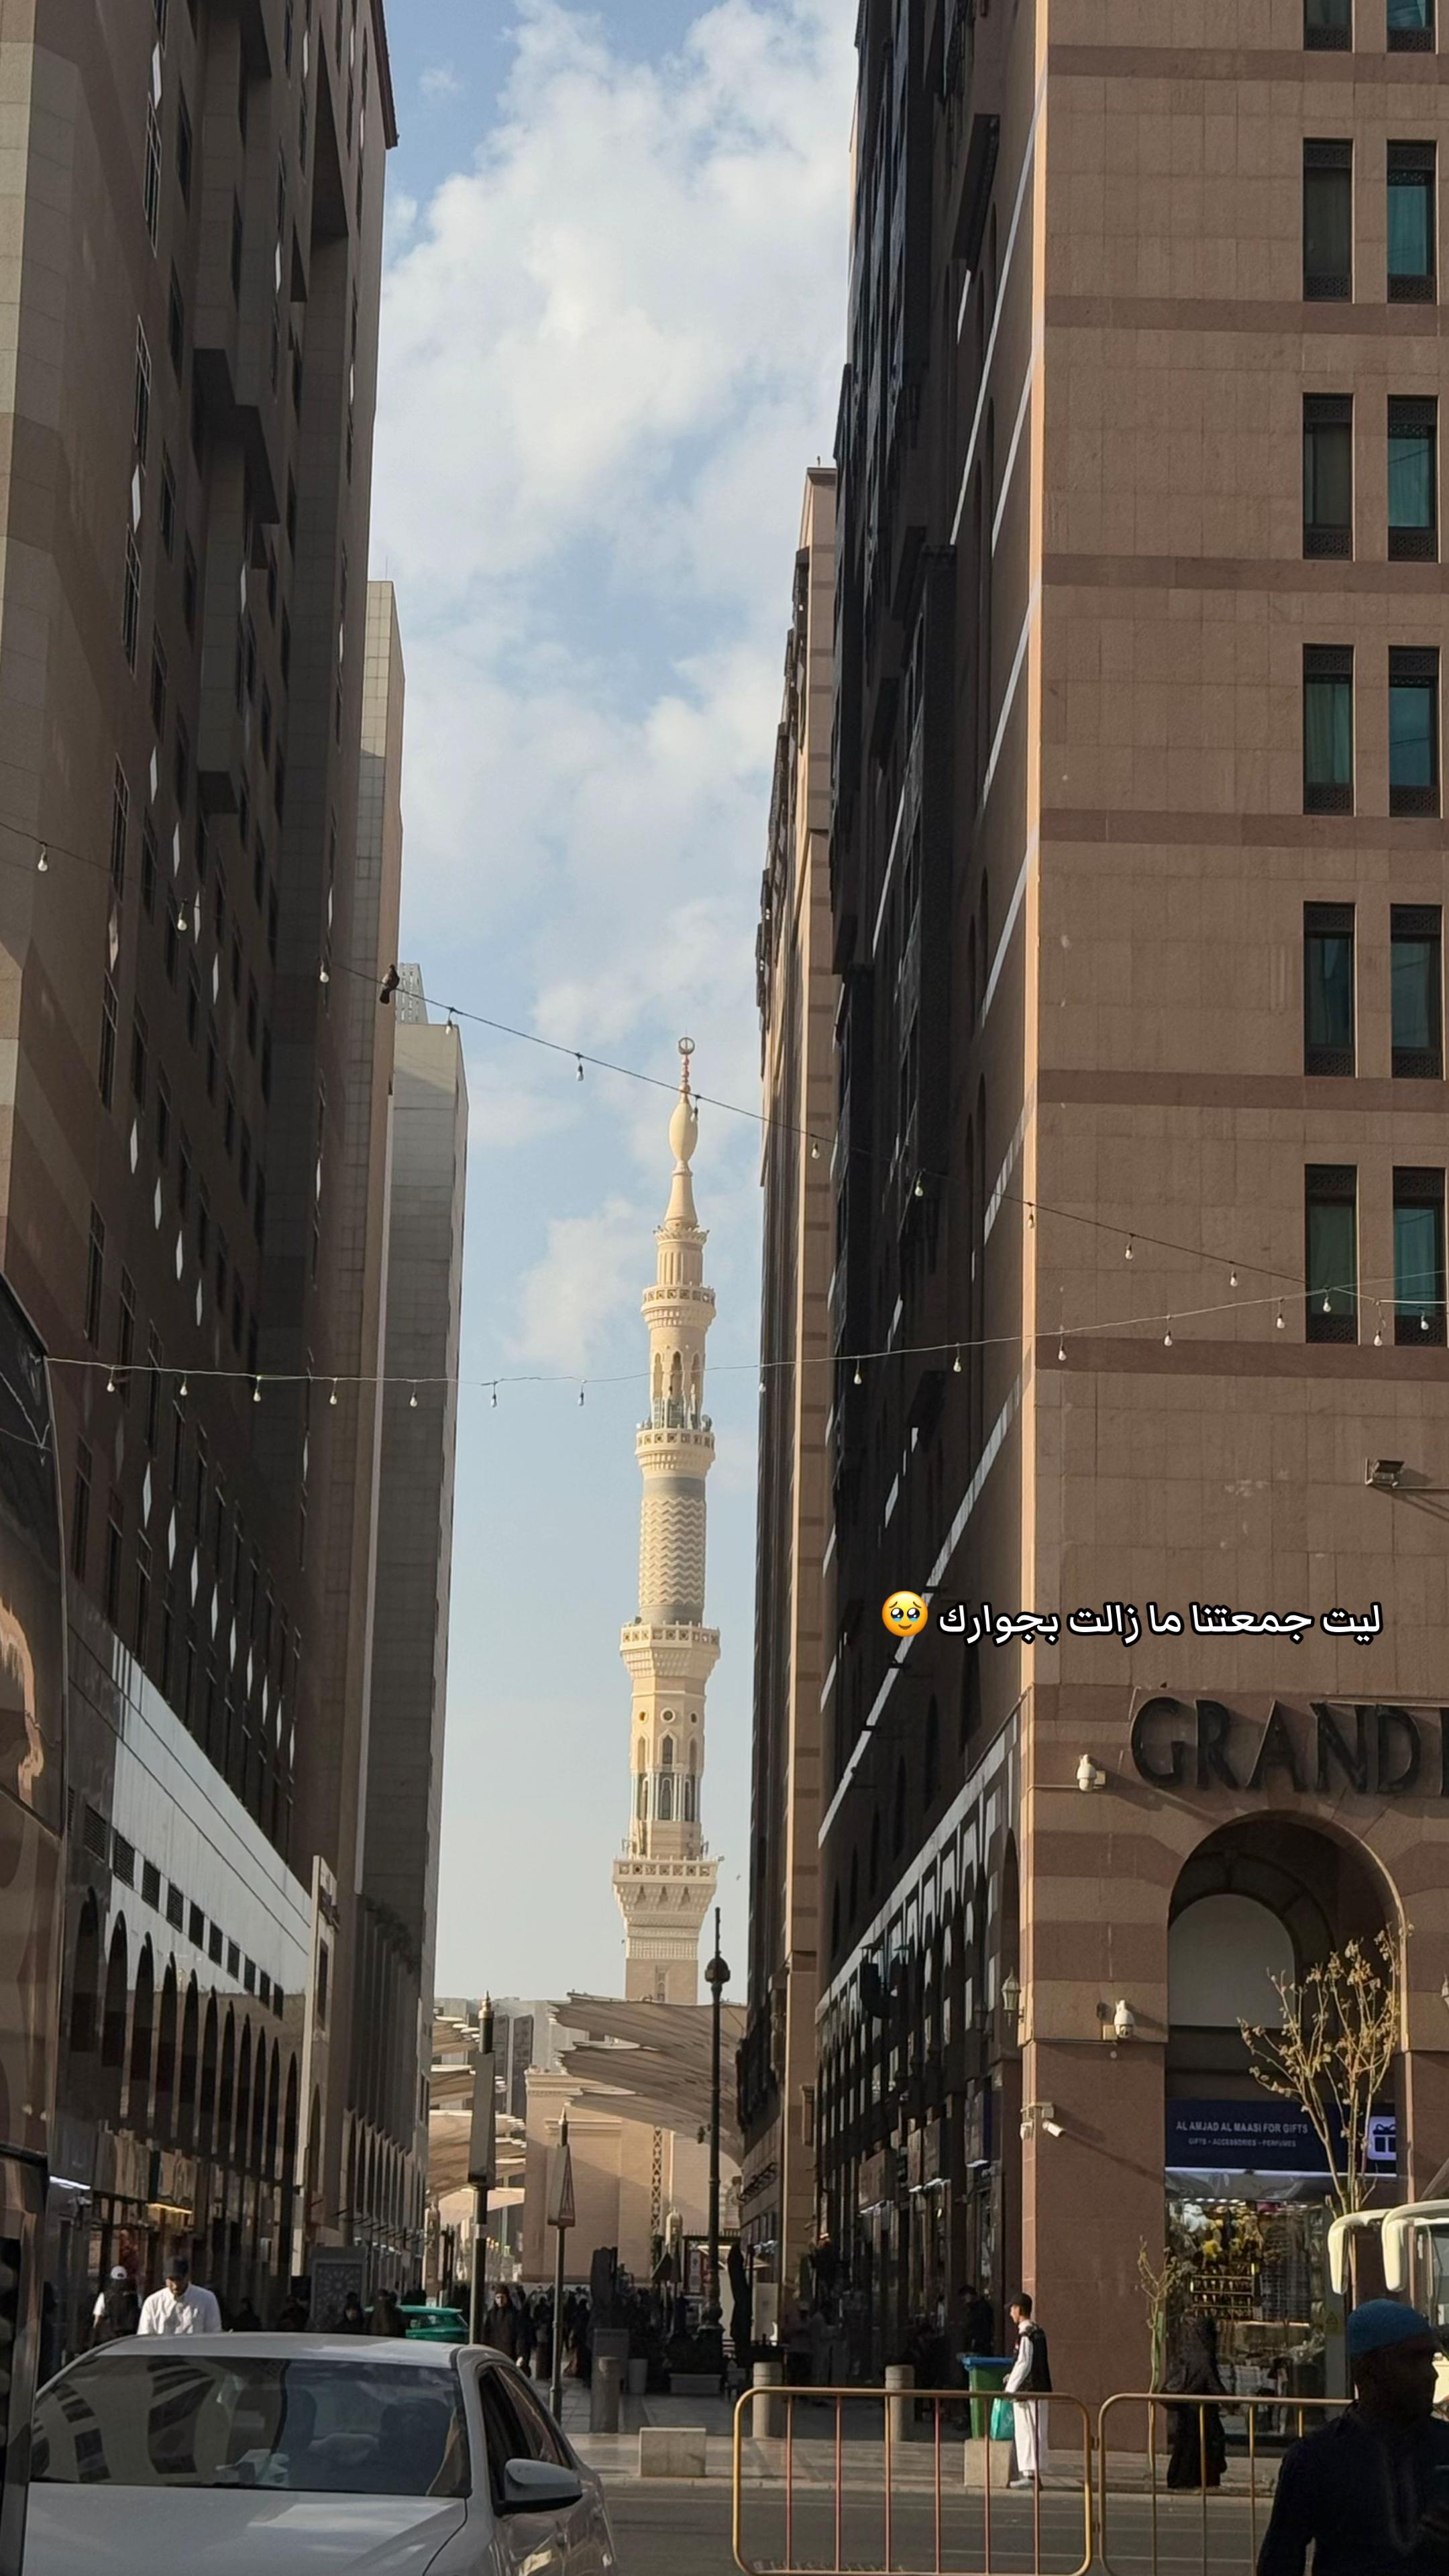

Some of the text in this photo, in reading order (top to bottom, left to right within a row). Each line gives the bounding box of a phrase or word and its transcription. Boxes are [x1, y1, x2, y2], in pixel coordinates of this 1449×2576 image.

[1131, 1695, 1421, 1794] GRAND
[1175, 2121, 1308, 2134] AL AMJAD AL MAASI FOR GIFTS
[1187, 2137, 1207, 2145] GIFTS
